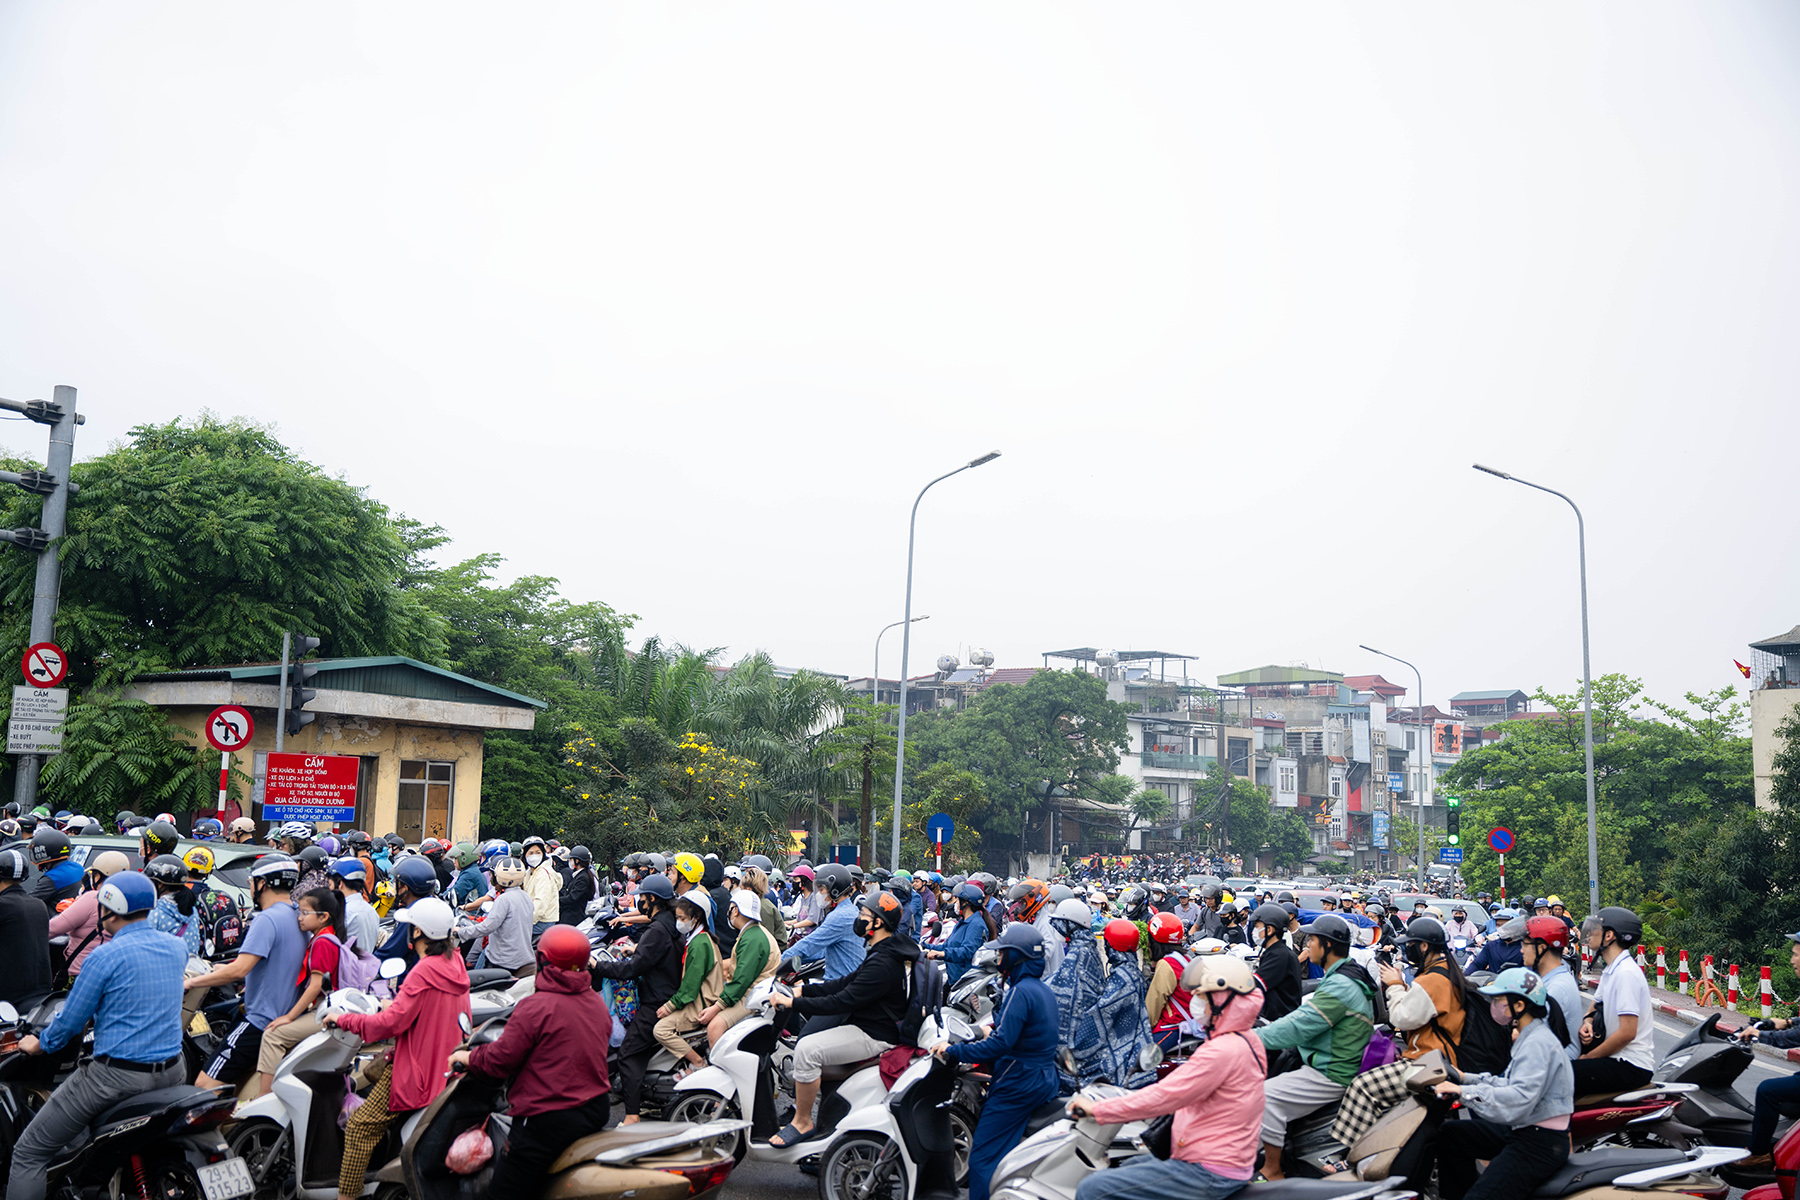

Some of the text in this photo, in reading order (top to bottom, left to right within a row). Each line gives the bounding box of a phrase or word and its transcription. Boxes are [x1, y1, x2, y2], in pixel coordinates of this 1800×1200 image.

[305, 755, 324, 767] CẤM
[206, 1162, 241, 1183] 29-K1
[208, 1176, 251, 1200] 315.23
